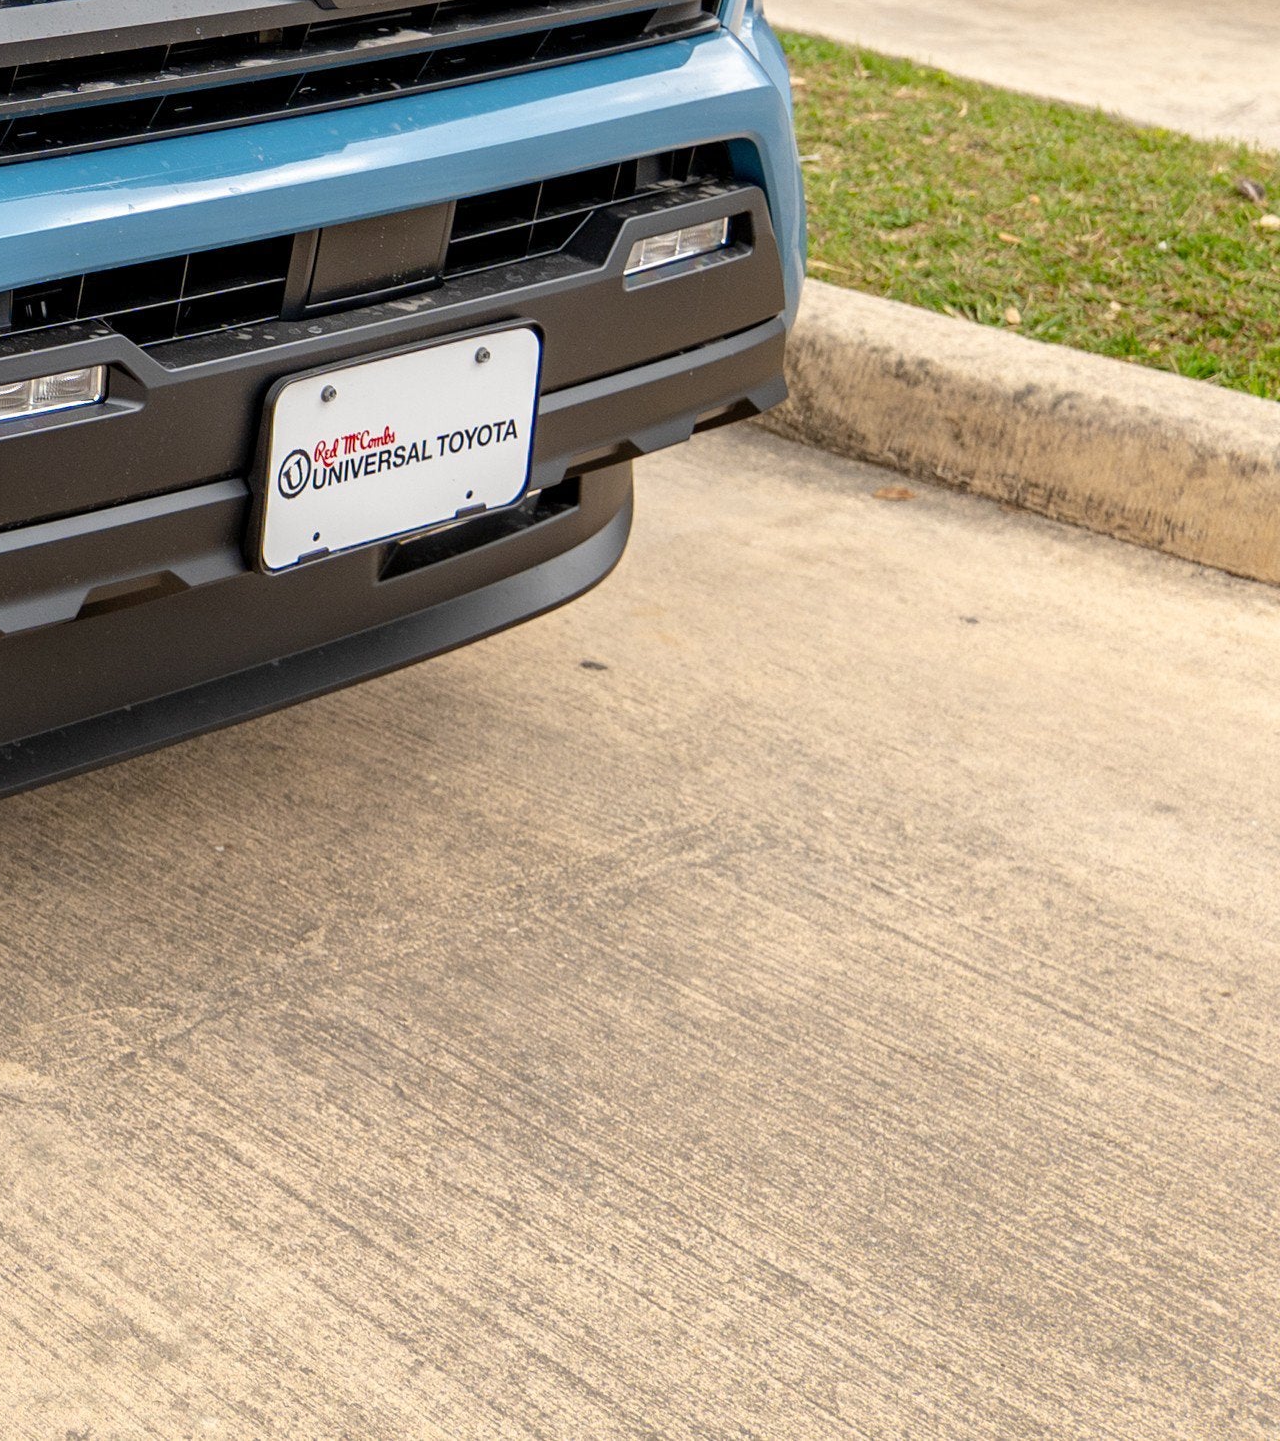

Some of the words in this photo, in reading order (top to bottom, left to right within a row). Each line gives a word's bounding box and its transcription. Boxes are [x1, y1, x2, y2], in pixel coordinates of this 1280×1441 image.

[312, 439, 433, 490] UNIVERSAL
[436, 418, 518, 457] TOYOTA
[313, 438, 339, 469] Red
[340, 425, 396, 459] McCombs
